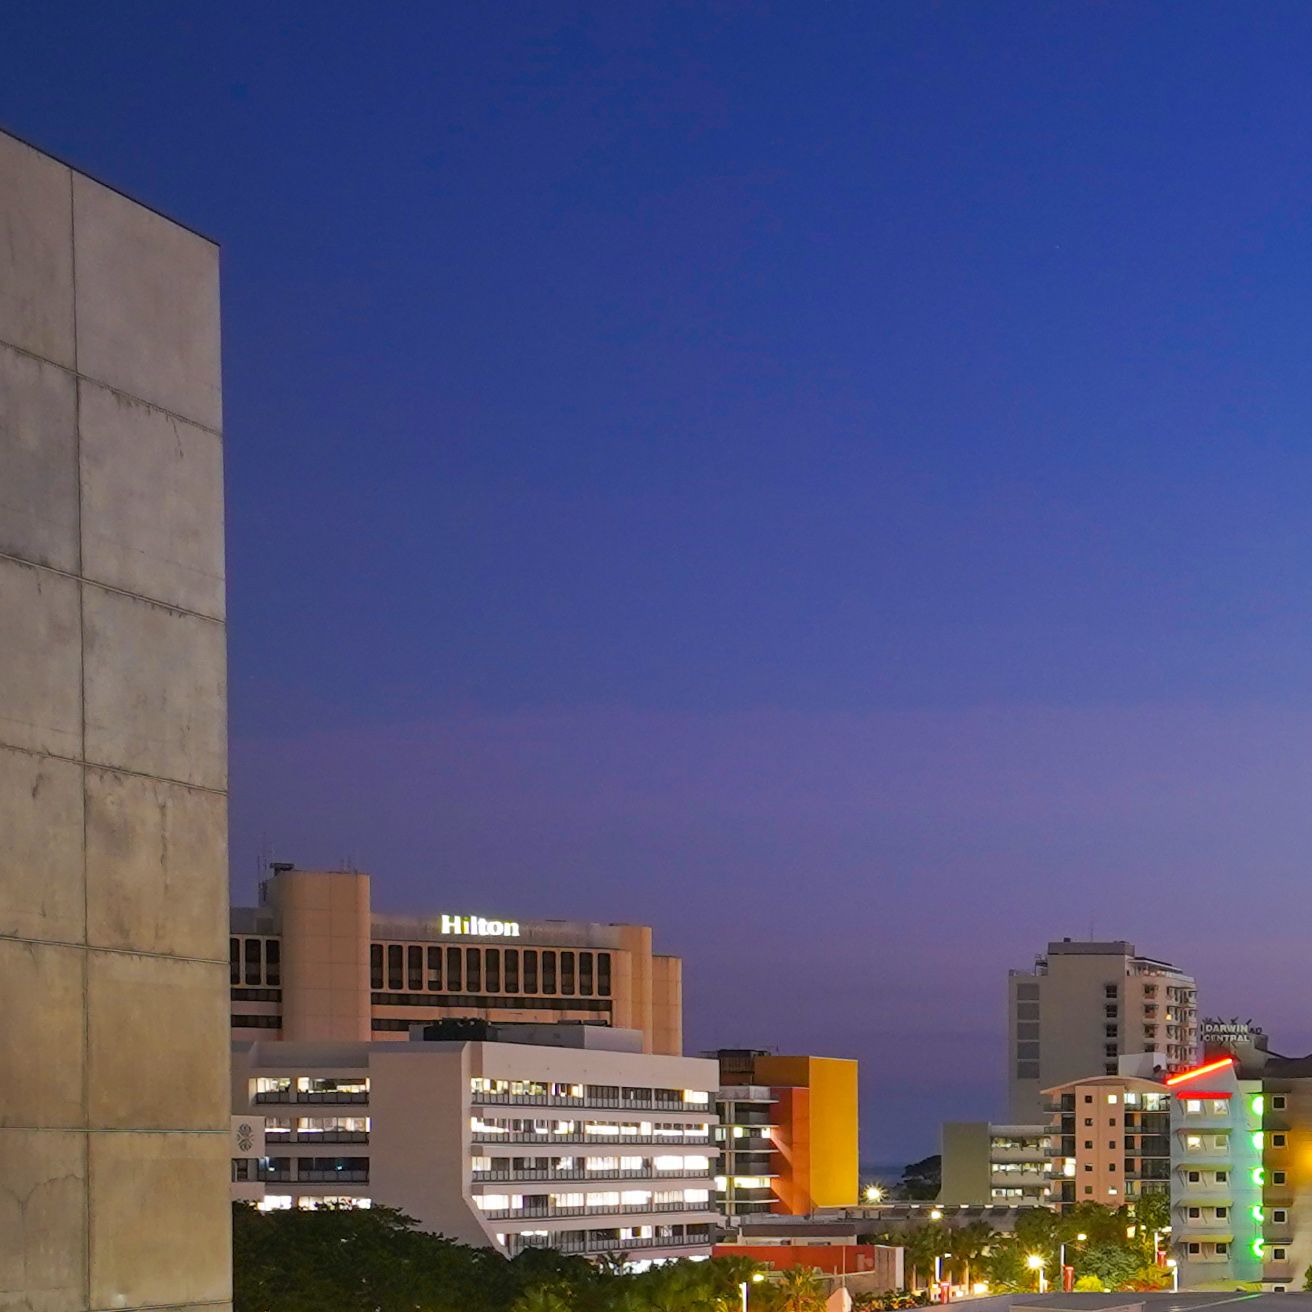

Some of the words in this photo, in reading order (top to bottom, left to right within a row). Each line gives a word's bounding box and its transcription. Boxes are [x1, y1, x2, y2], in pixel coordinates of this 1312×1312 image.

[441, 914, 520, 937] Hilton
[1205, 1024, 1249, 1034] DARWIN
[1203, 1034, 1250, 1042] CENTRAL
